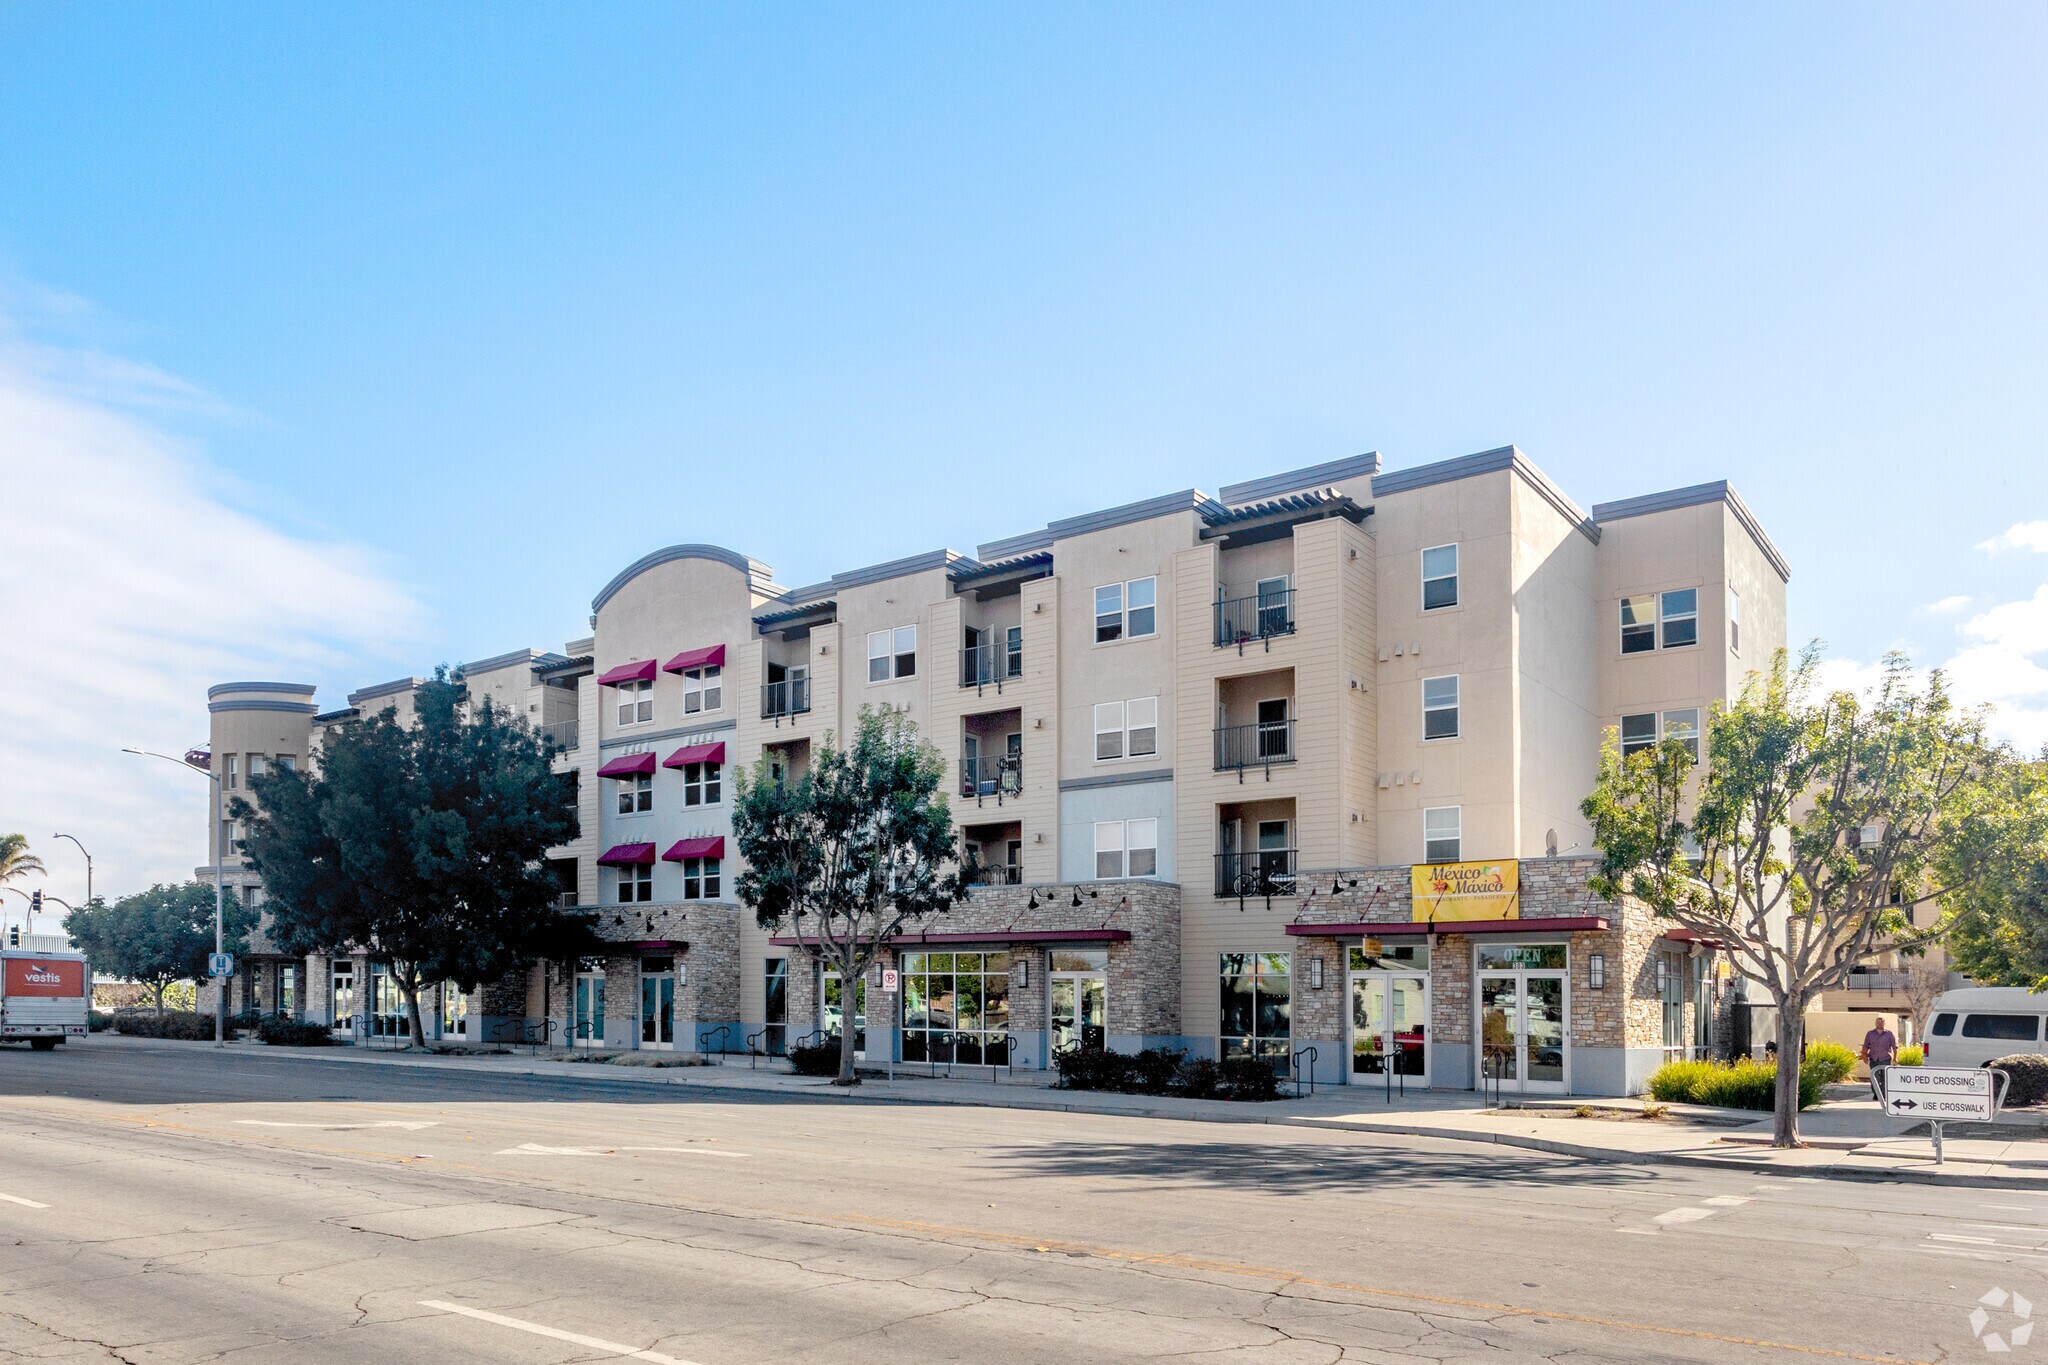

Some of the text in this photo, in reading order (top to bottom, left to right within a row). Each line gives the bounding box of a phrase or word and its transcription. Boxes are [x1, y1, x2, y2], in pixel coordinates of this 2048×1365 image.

[1429, 866, 1483, 881] México
[1452, 880, 1504, 894] Máxico
[1503, 948, 1541, 962] OPEN
[24, 973, 61, 983] vestis
[1900, 1075, 1912, 1084] NO
[1915, 1076, 1930, 1085] PED
[1933, 1077, 1976, 1087] CROSSING
[1922, 1102, 1985, 1113] USE CROSSWALK
